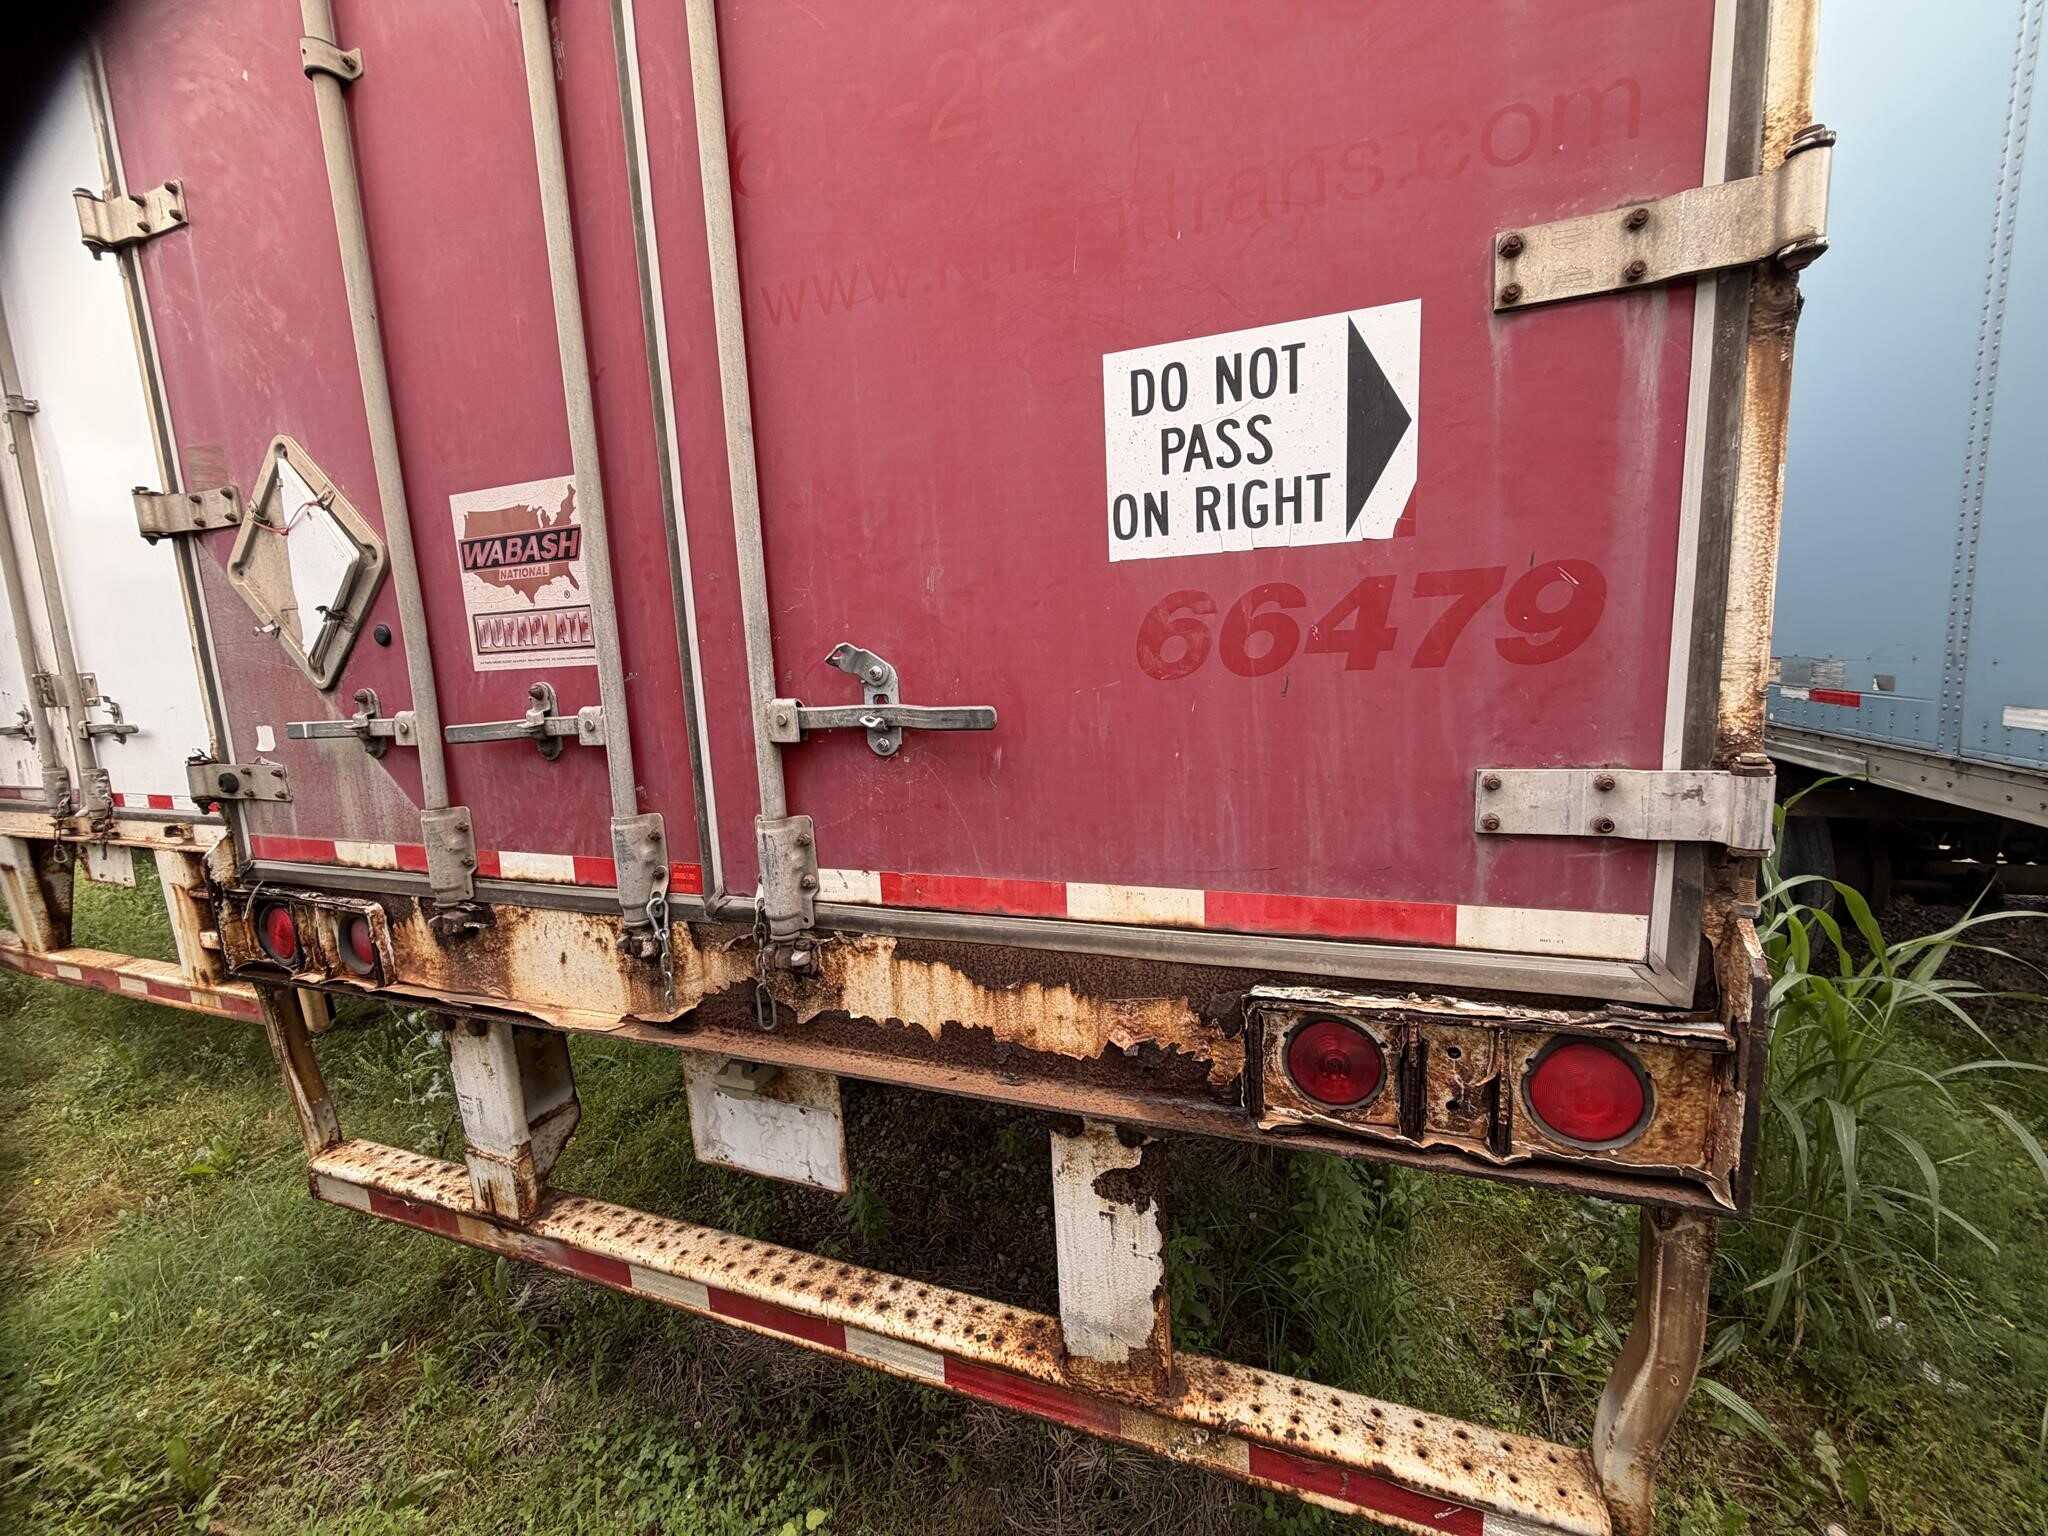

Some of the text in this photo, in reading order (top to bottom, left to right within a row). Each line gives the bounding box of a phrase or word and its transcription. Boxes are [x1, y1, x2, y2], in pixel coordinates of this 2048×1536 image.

[1130, 342, 1306, 417] DO NOT
[1160, 414, 1274, 475] PASS
[1112, 472, 1331, 541] ON RIGHT
[462, 529, 579, 569] WABASH
[500, 566, 549, 580] NATIONAL
[478, 611, 591, 648] DURAPLATE
[1136, 559, 1607, 681] 66479
